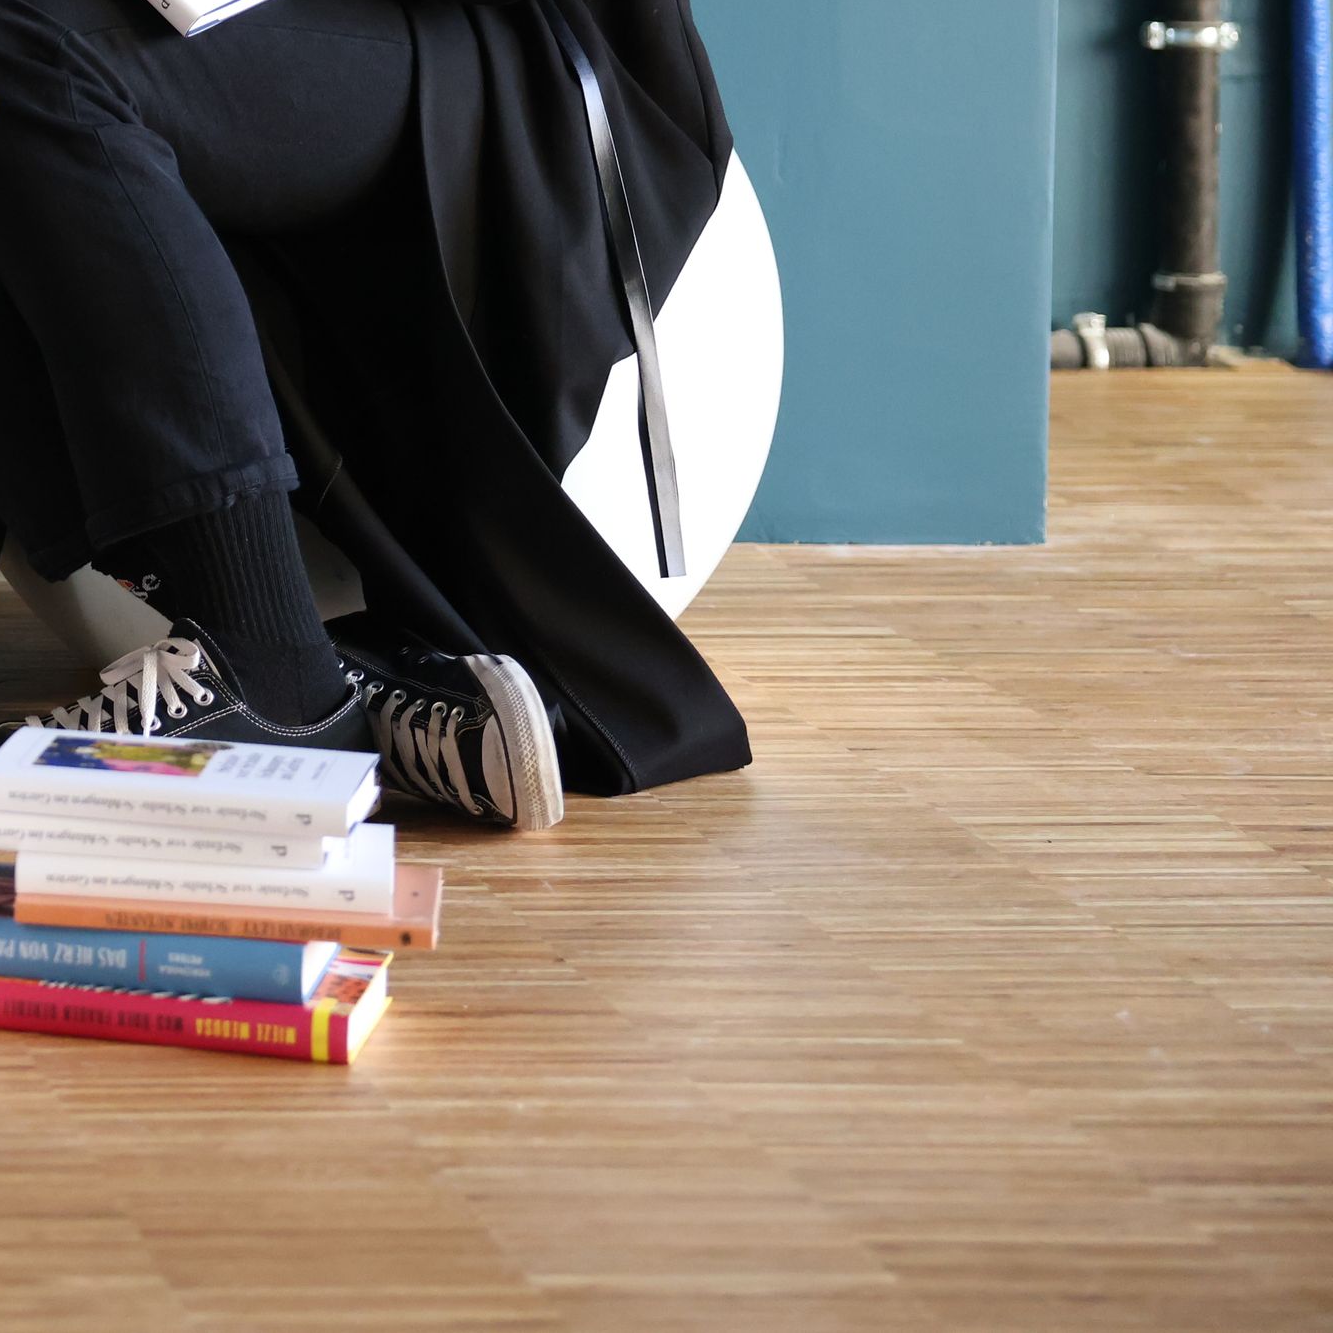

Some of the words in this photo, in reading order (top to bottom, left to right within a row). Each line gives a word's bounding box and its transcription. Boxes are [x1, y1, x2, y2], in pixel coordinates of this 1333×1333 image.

[18, 940, 49, 962] VON
[53, 944, 93, 967] HERZ
[96, 949, 127, 969] DAS
[196, 1017, 250, 1041] MEDUSA
[256, 1022, 295, 1044] MIEZE
